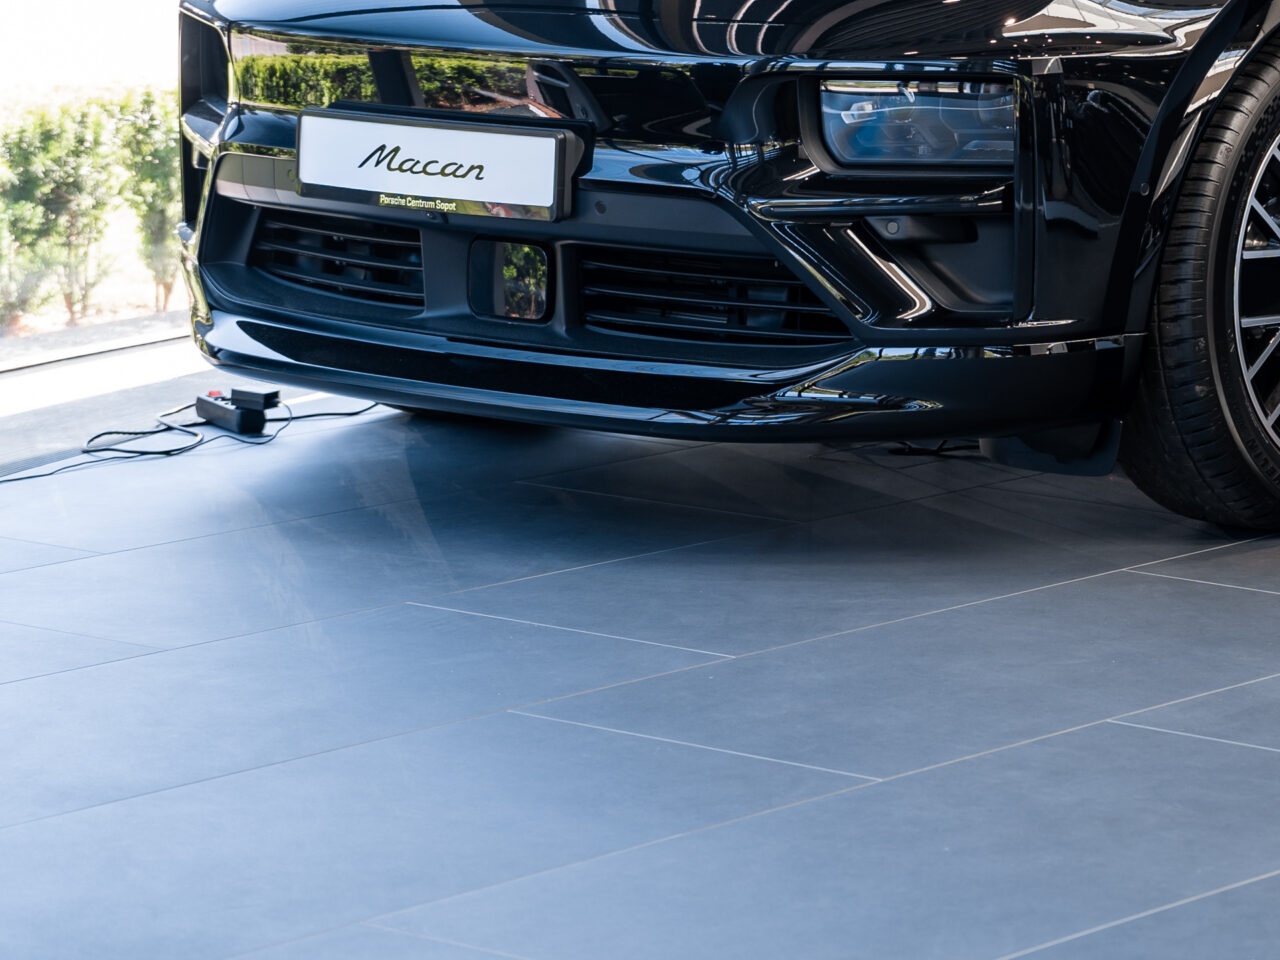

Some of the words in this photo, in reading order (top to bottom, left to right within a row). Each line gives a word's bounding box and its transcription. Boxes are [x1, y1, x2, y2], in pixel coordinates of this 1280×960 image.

[358, 144, 485, 180] Macan
[379, 194, 406, 206] Porsche
[406, 197, 435, 208] Centrum
[436, 200, 456, 212] Sopot
